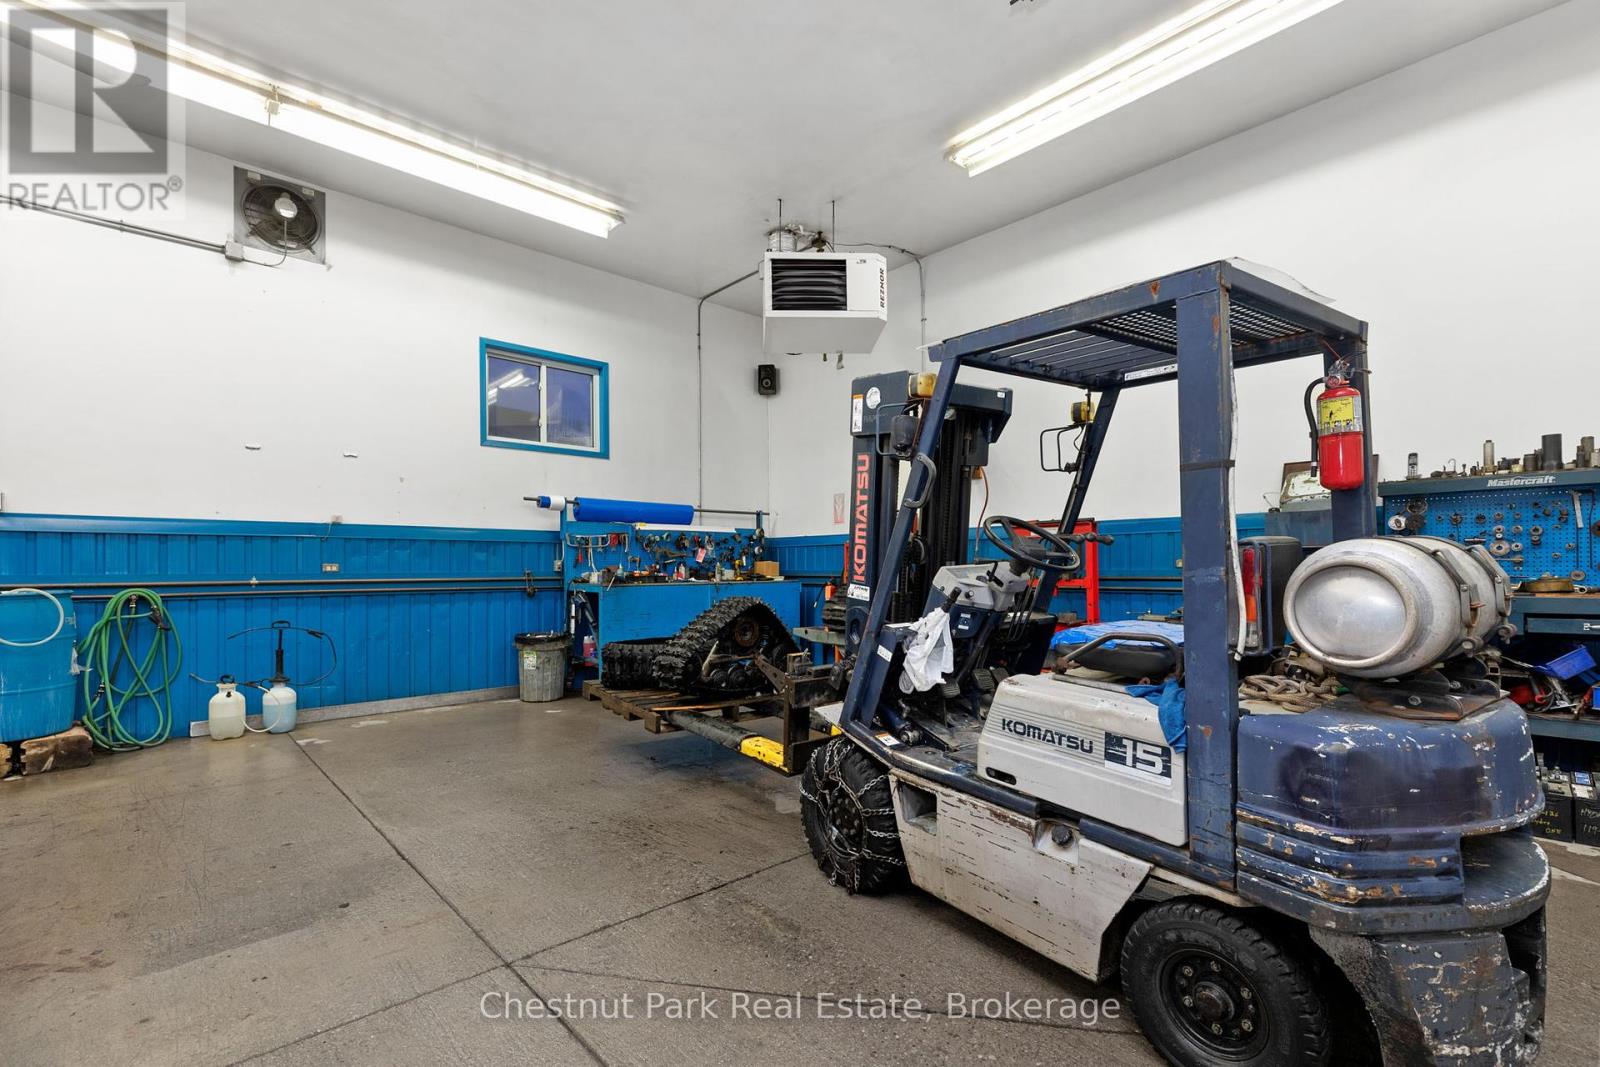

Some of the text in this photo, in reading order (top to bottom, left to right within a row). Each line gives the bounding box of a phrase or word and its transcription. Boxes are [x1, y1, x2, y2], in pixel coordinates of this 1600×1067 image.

[1487, 476, 1554, 487] Mastercraft
[852, 453, 870, 583] KOMATSU
[1001, 718, 1094, 754] KOMATSU
[1120, 738, 1163, 775] 15
